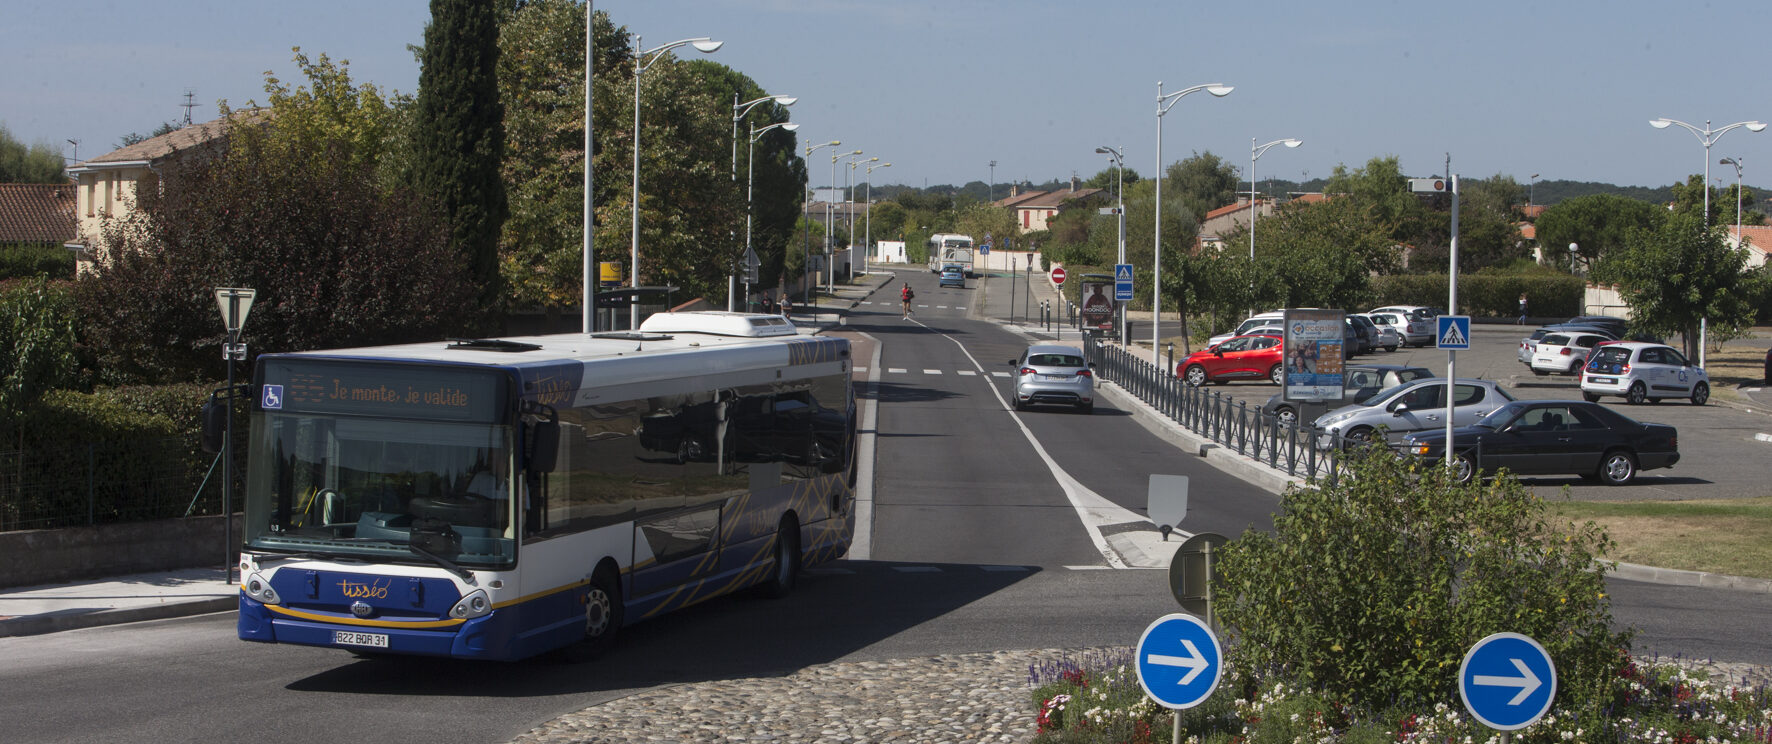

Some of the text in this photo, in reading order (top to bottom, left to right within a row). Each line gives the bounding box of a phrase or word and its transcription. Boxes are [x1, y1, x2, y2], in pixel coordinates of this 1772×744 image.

[329, 378, 348, 400] Je
[405, 386, 420, 404] je
[424, 387, 468, 407] valide
[336, 577, 392, 599] tisséo
[337, 632, 386, 646] 822 BQR 31
